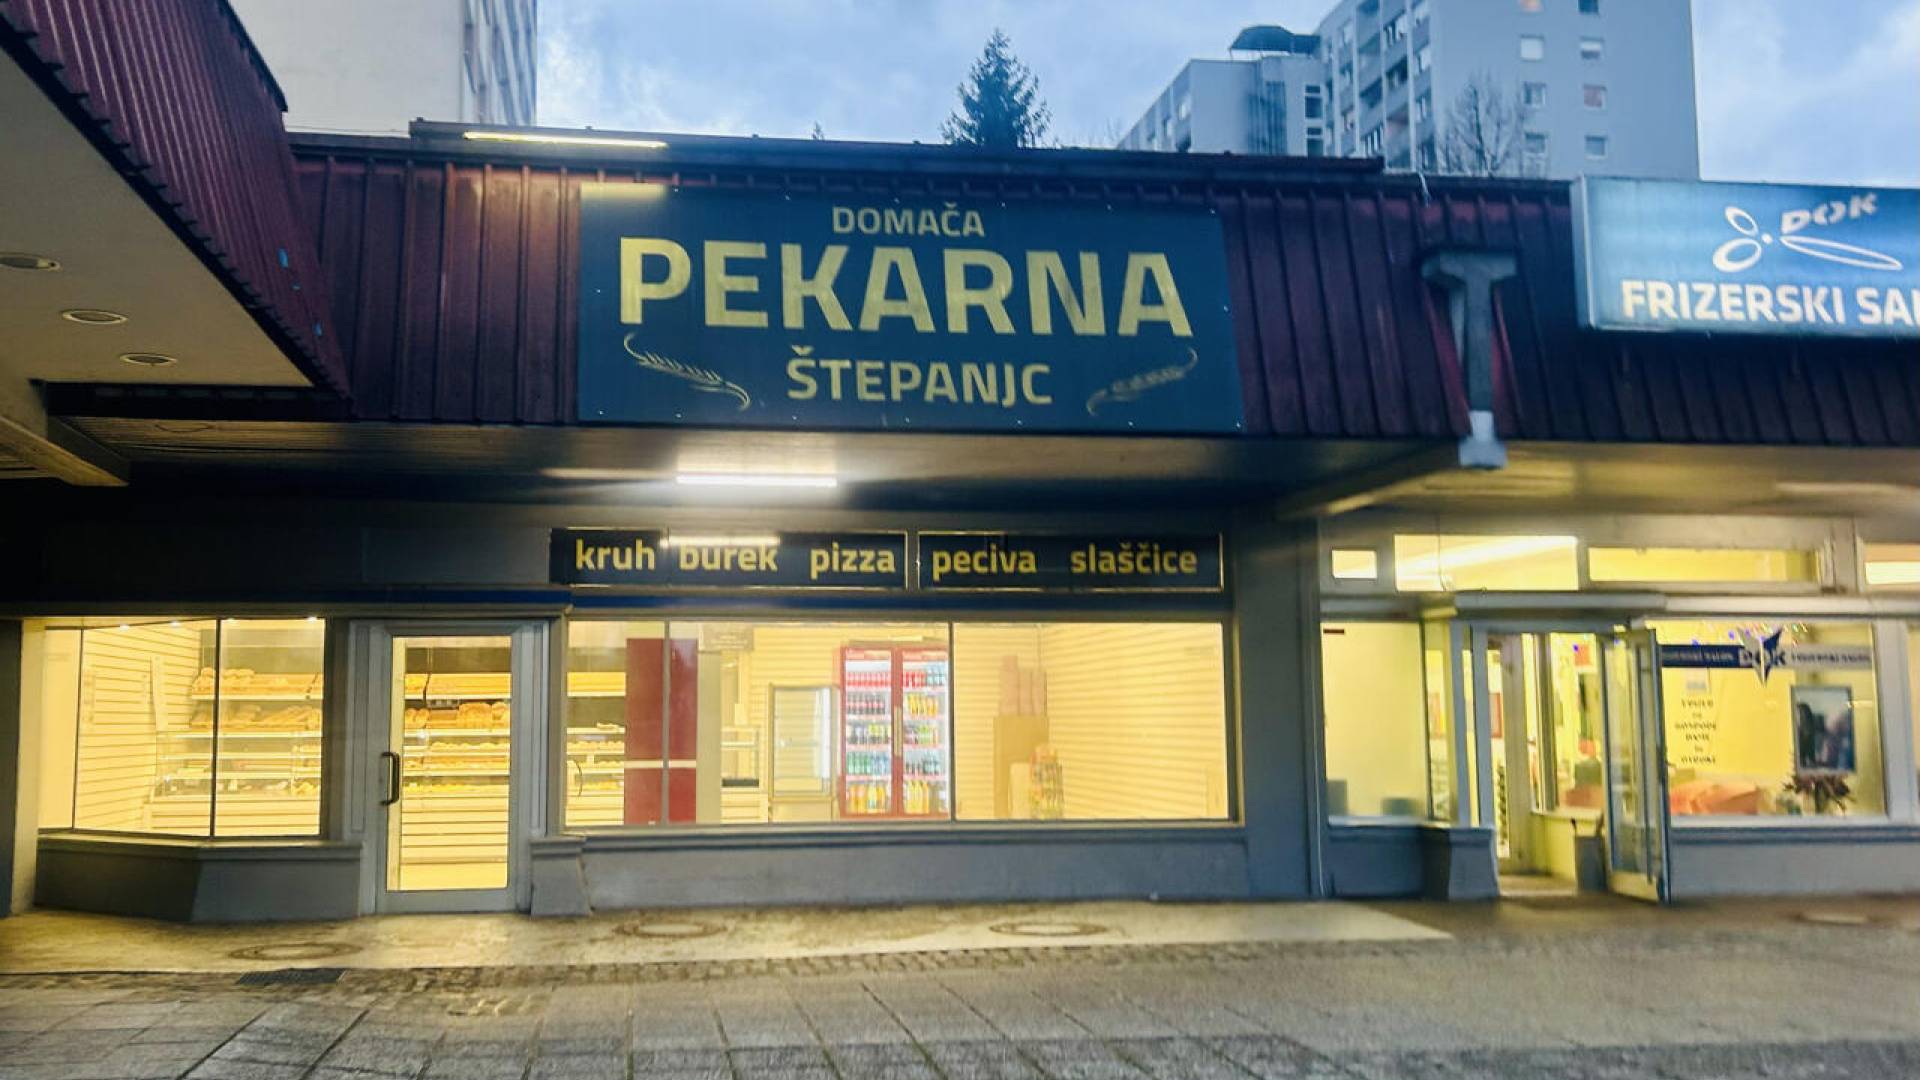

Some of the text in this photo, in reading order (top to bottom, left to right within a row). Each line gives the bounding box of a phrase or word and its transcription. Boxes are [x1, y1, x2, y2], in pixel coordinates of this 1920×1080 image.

[832, 201, 985, 238] DOMAČA
[1780, 191, 1877, 235] DOK
[619, 236, 1193, 337] PEKARNA
[1620, 279, 1846, 325] FRIZERSKI
[786, 344, 1053, 408] ŠTEPANJC
[575, 537, 896, 581] kruh burek pizza
[932, 542, 1198, 582] peciva slaščice
